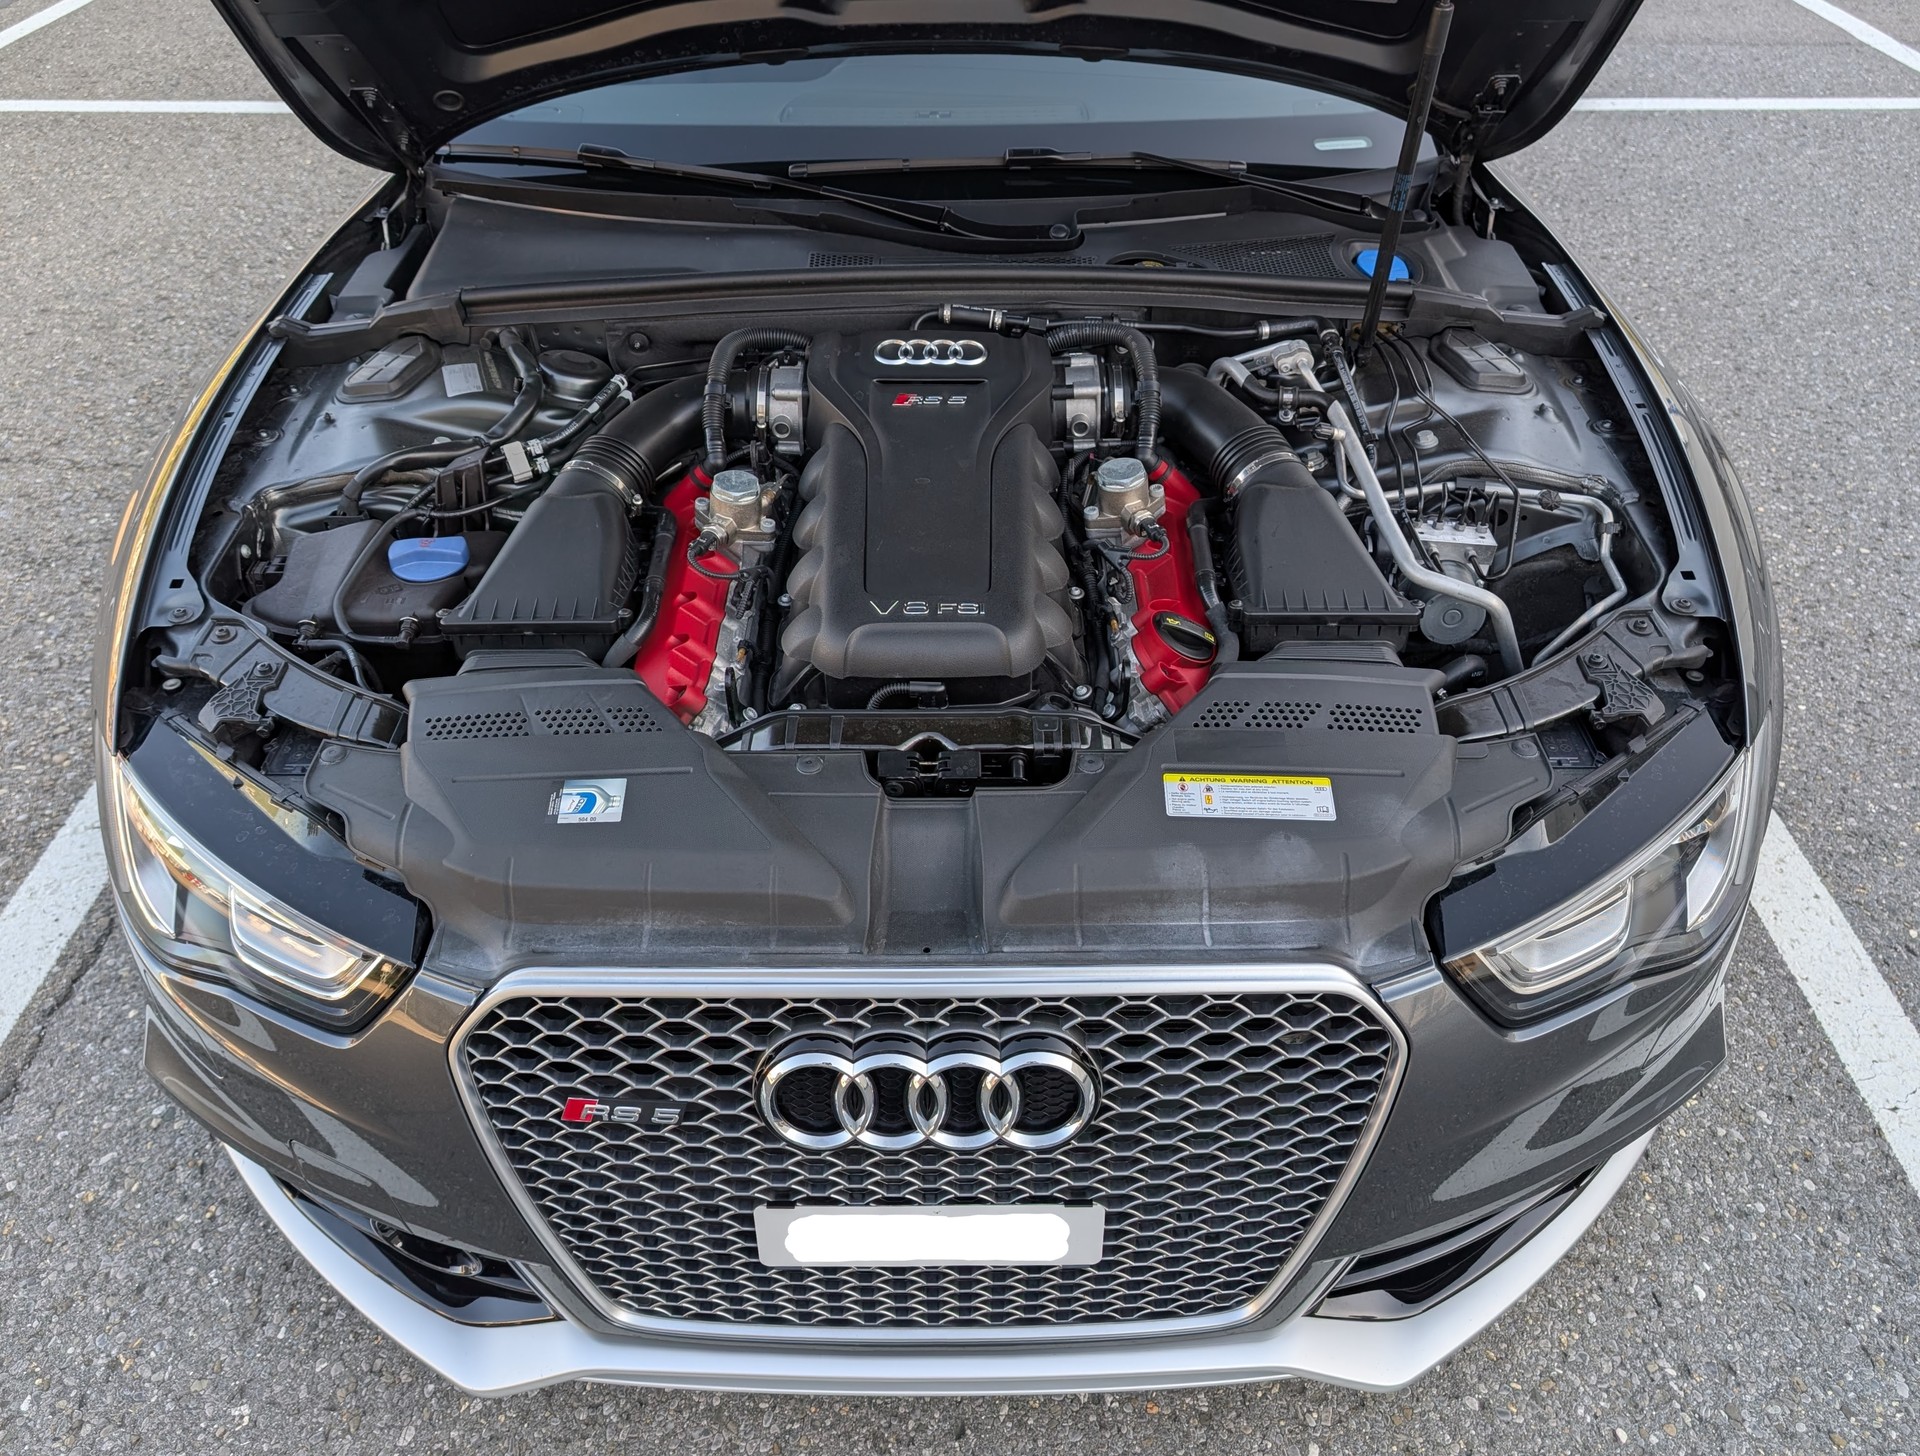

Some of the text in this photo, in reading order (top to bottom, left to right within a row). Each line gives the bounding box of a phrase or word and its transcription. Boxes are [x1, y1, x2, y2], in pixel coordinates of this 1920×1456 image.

[902, 395, 967, 405] RS 5
[870, 600, 985, 615] V8 FSI
[1189, 776, 1313, 786] ACHTUNG WARNING ATTENTION
[579, 1103, 681, 1125] RS 5
